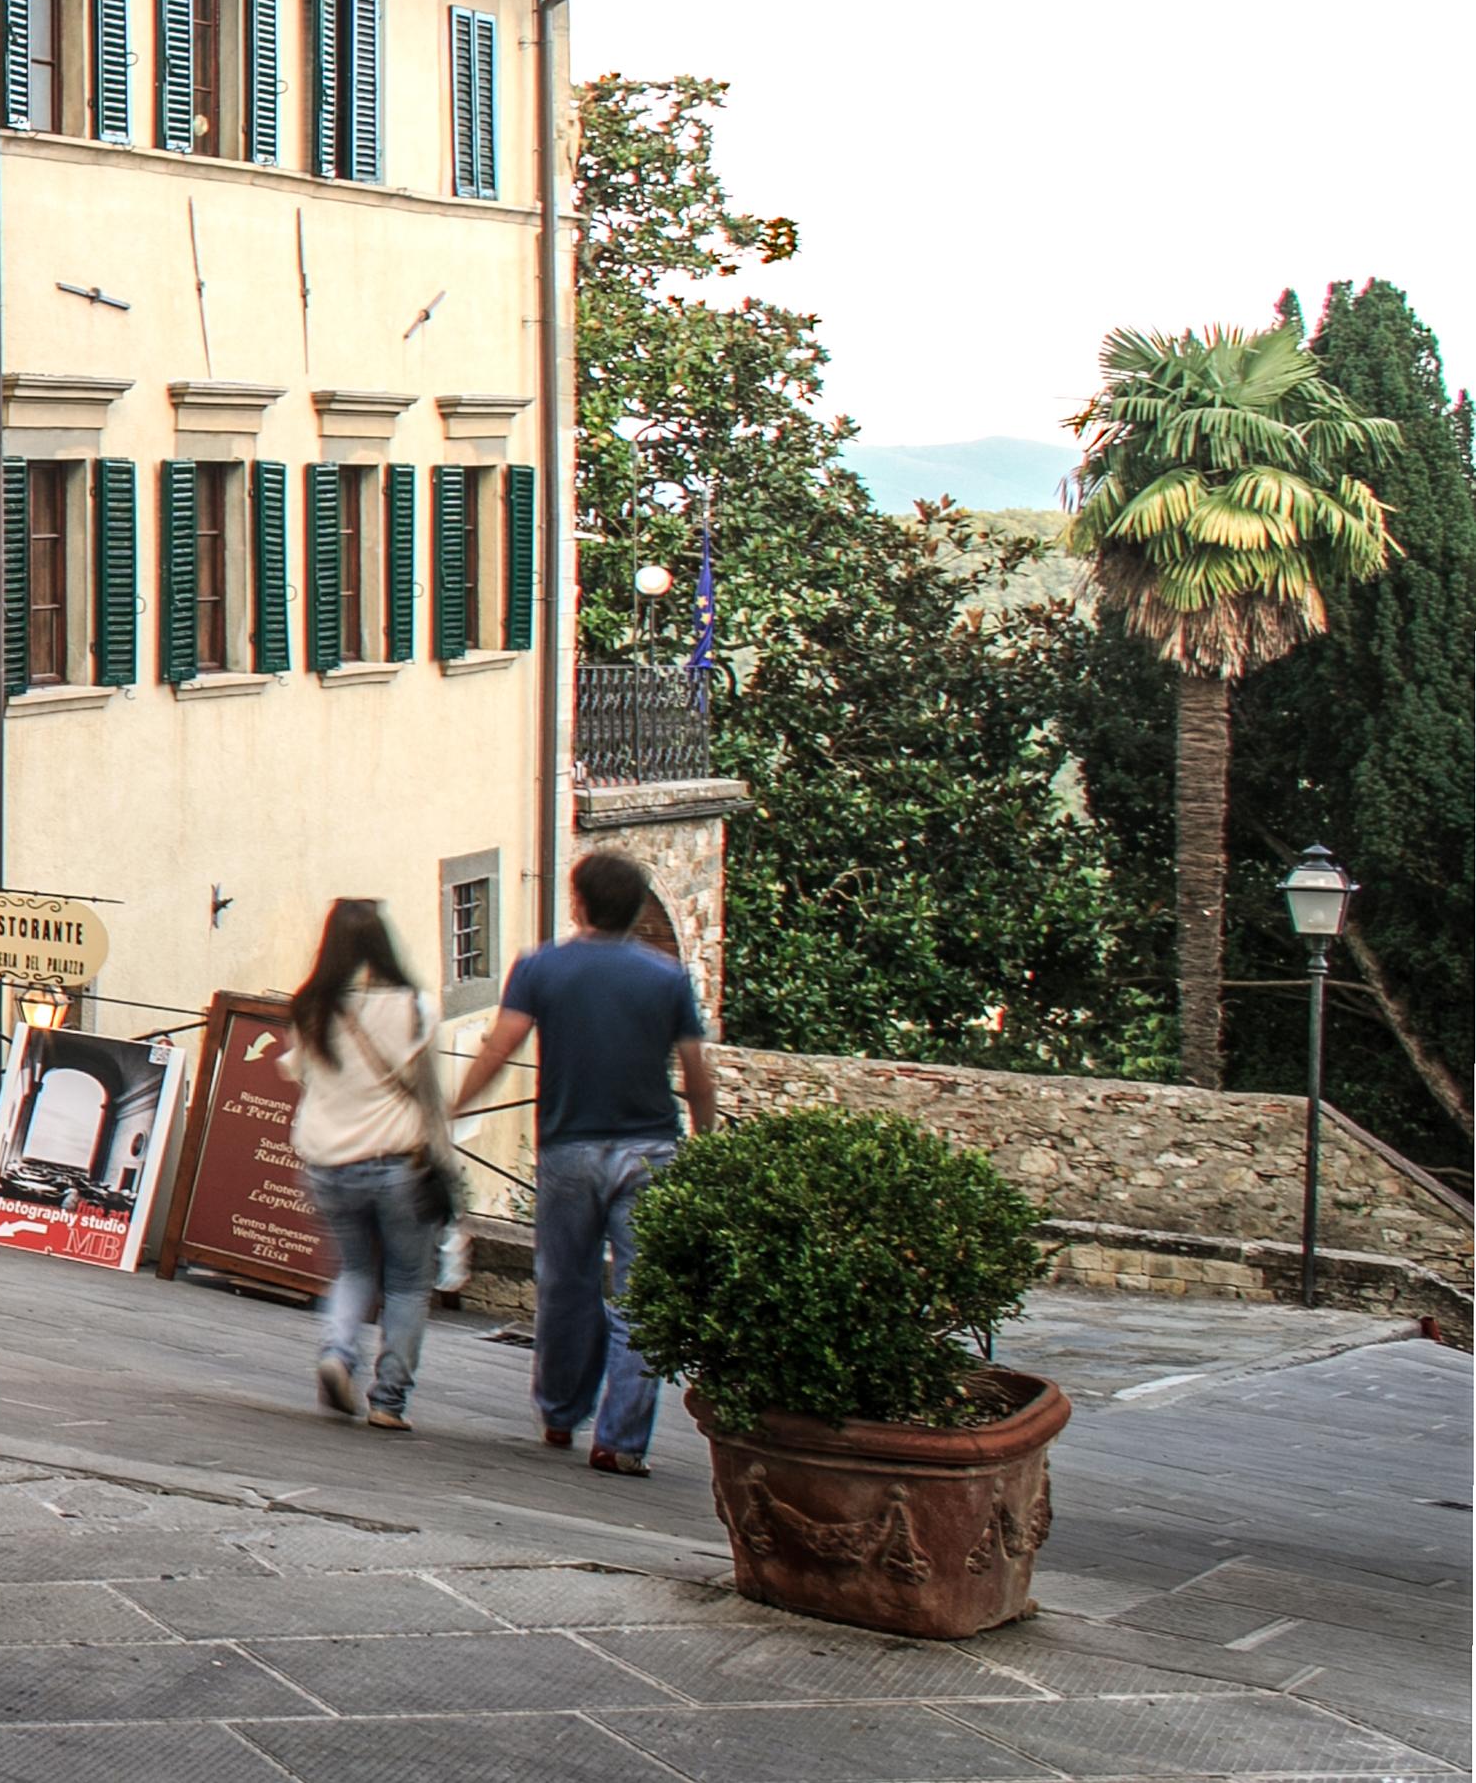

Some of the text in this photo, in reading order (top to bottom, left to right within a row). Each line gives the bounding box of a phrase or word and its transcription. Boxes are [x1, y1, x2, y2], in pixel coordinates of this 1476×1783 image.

[25, 955, 40, 971] DEL
[47, 957, 85, 975] PALAZZO
[240, 1091, 292, 1112] Ristorante
[222, 1100, 243, 1114] La
[246, 1105, 287, 1125] Perla
[259, 1137, 294, 1154] Studio
[263, 1179, 306, 1198] Enoteca
[248, 1188, 317, 1215] Leopoldo
[77, 1200, 130, 1225] fine art
[80, 1215, 127, 1235] studio
[231, 1214, 320, 1244] Centro Benessere
[232, 1225, 313, 1256] Wellness Centre
[251, 1243, 290, 1263] Elisa
